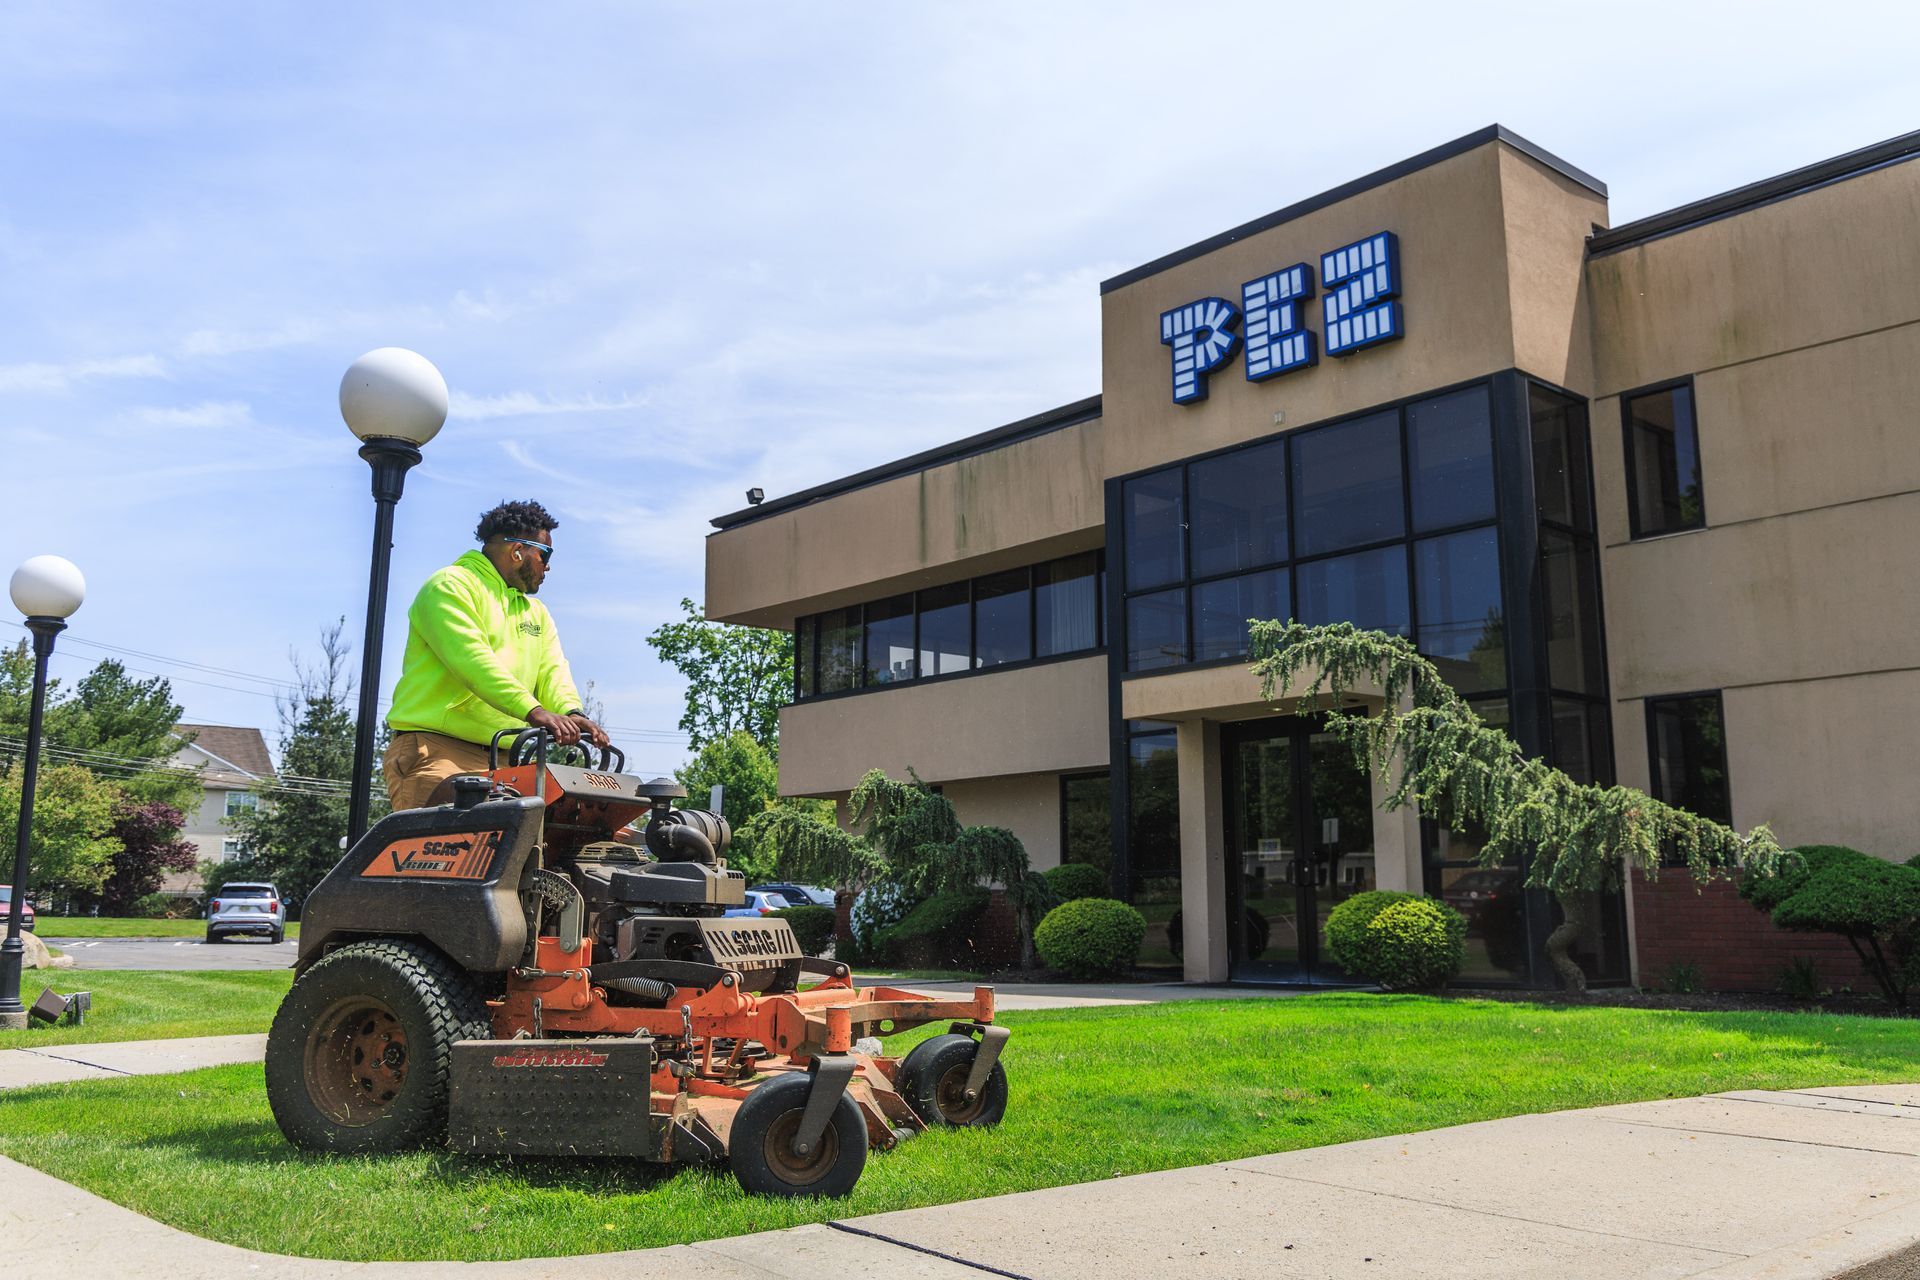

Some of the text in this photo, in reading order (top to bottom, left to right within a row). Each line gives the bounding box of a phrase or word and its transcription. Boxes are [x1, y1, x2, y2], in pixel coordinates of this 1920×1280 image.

[1160, 230, 1404, 406] PEZ
[584, 772, 621, 791] SCAG
[731, 930, 777, 956] SCAG
